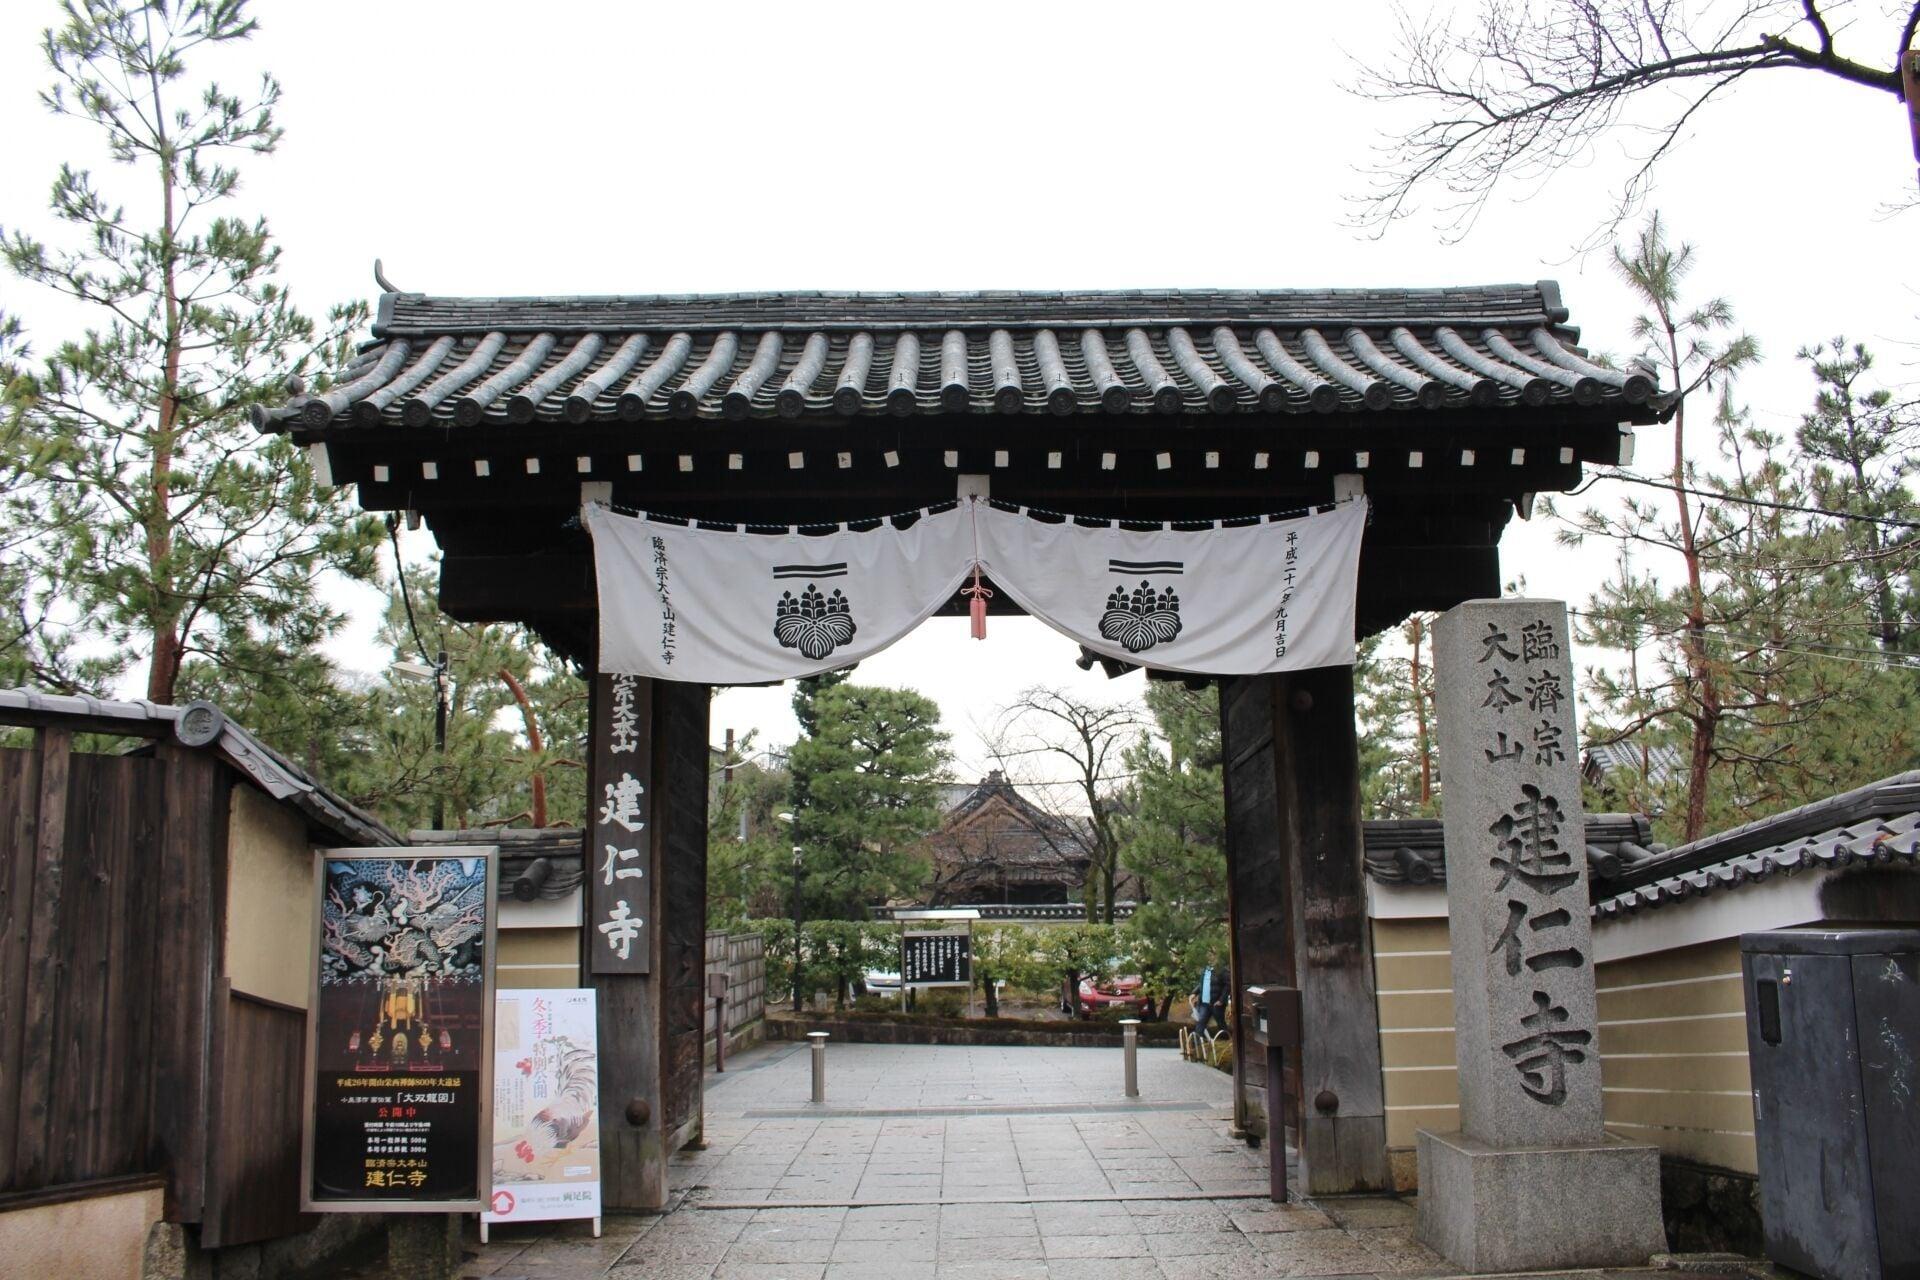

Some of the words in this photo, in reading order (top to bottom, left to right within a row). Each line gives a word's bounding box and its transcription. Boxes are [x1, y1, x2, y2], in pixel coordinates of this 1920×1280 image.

[652, 536, 676, 665] 臨済宗大本山建仁寺
[1275, 531, 1298, 658] 平成二十一年九月吉日
[1477, 622, 1524, 765] 大本山
[598, 773, 645, 960] 建仁寺
[1489, 783, 1593, 1106] 建仁寺
[365, 1169, 427, 1187] 建仁寺
